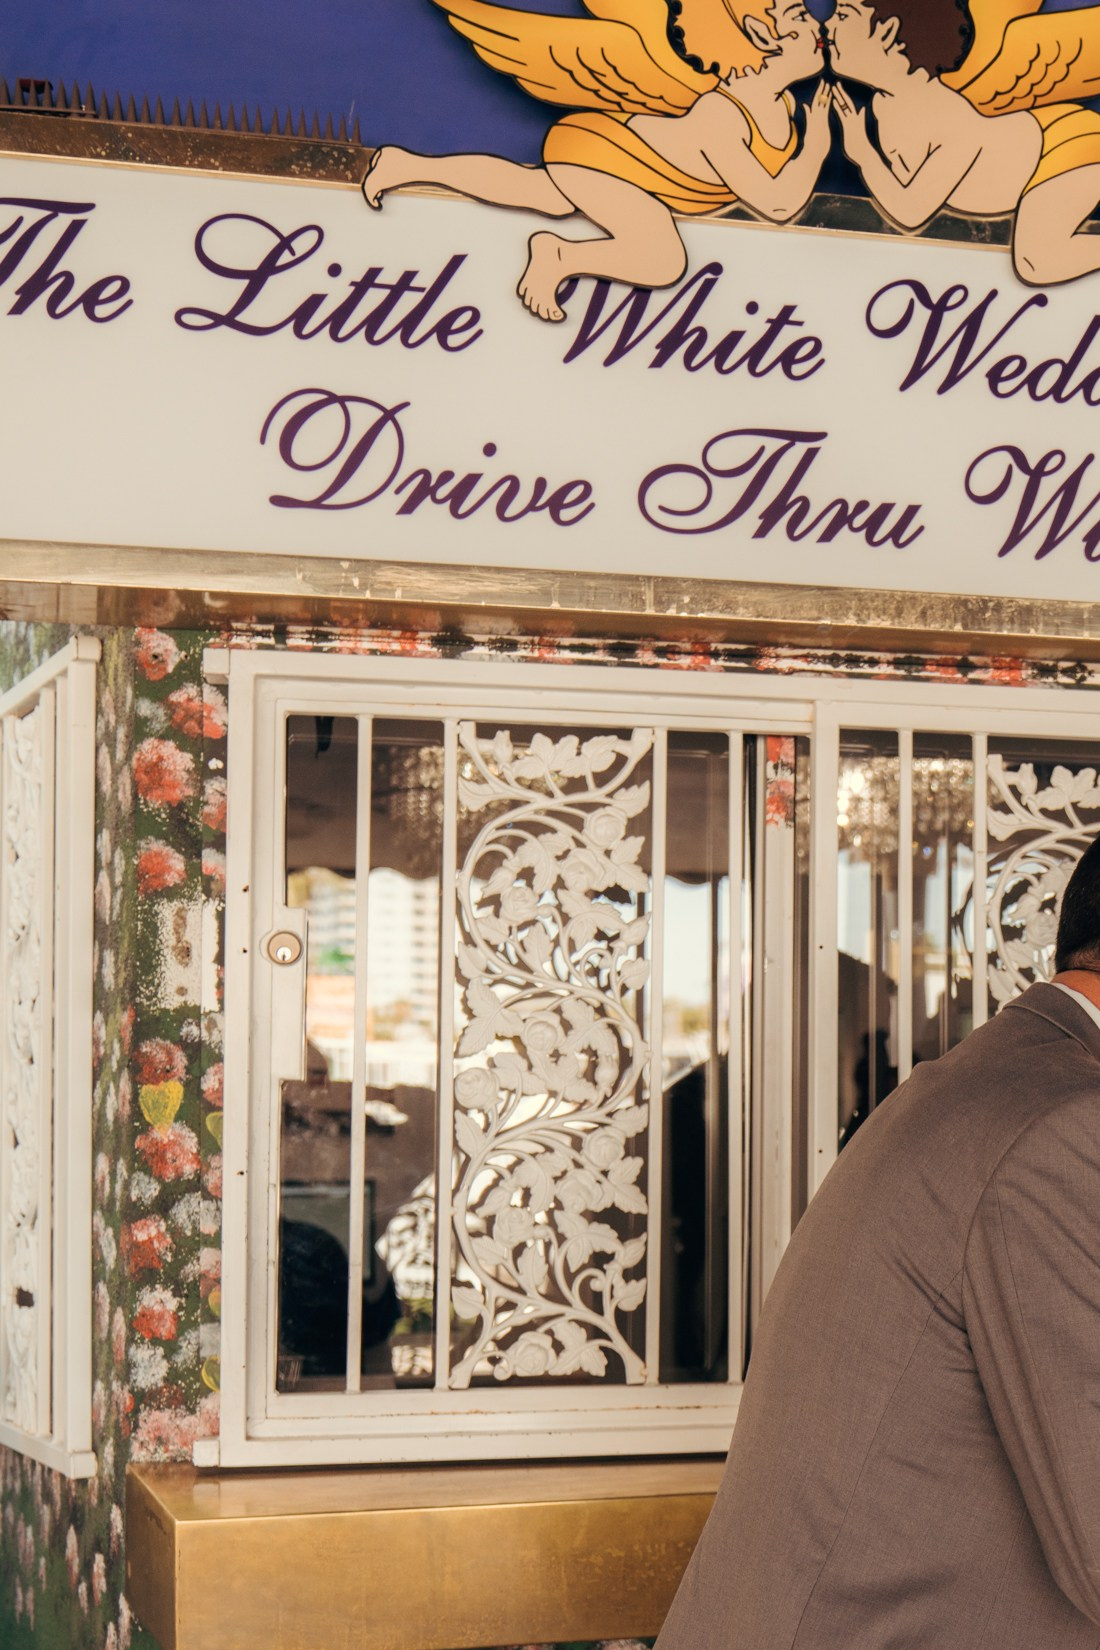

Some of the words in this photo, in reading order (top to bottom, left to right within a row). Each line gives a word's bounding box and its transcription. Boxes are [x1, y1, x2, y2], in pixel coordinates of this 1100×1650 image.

[0, 197, 134, 324] The
[174, 213, 484, 353] Little
[556, 261, 826, 381] White
[260, 387, 596, 527] Drive
[637, 428, 925, 550] Thru
